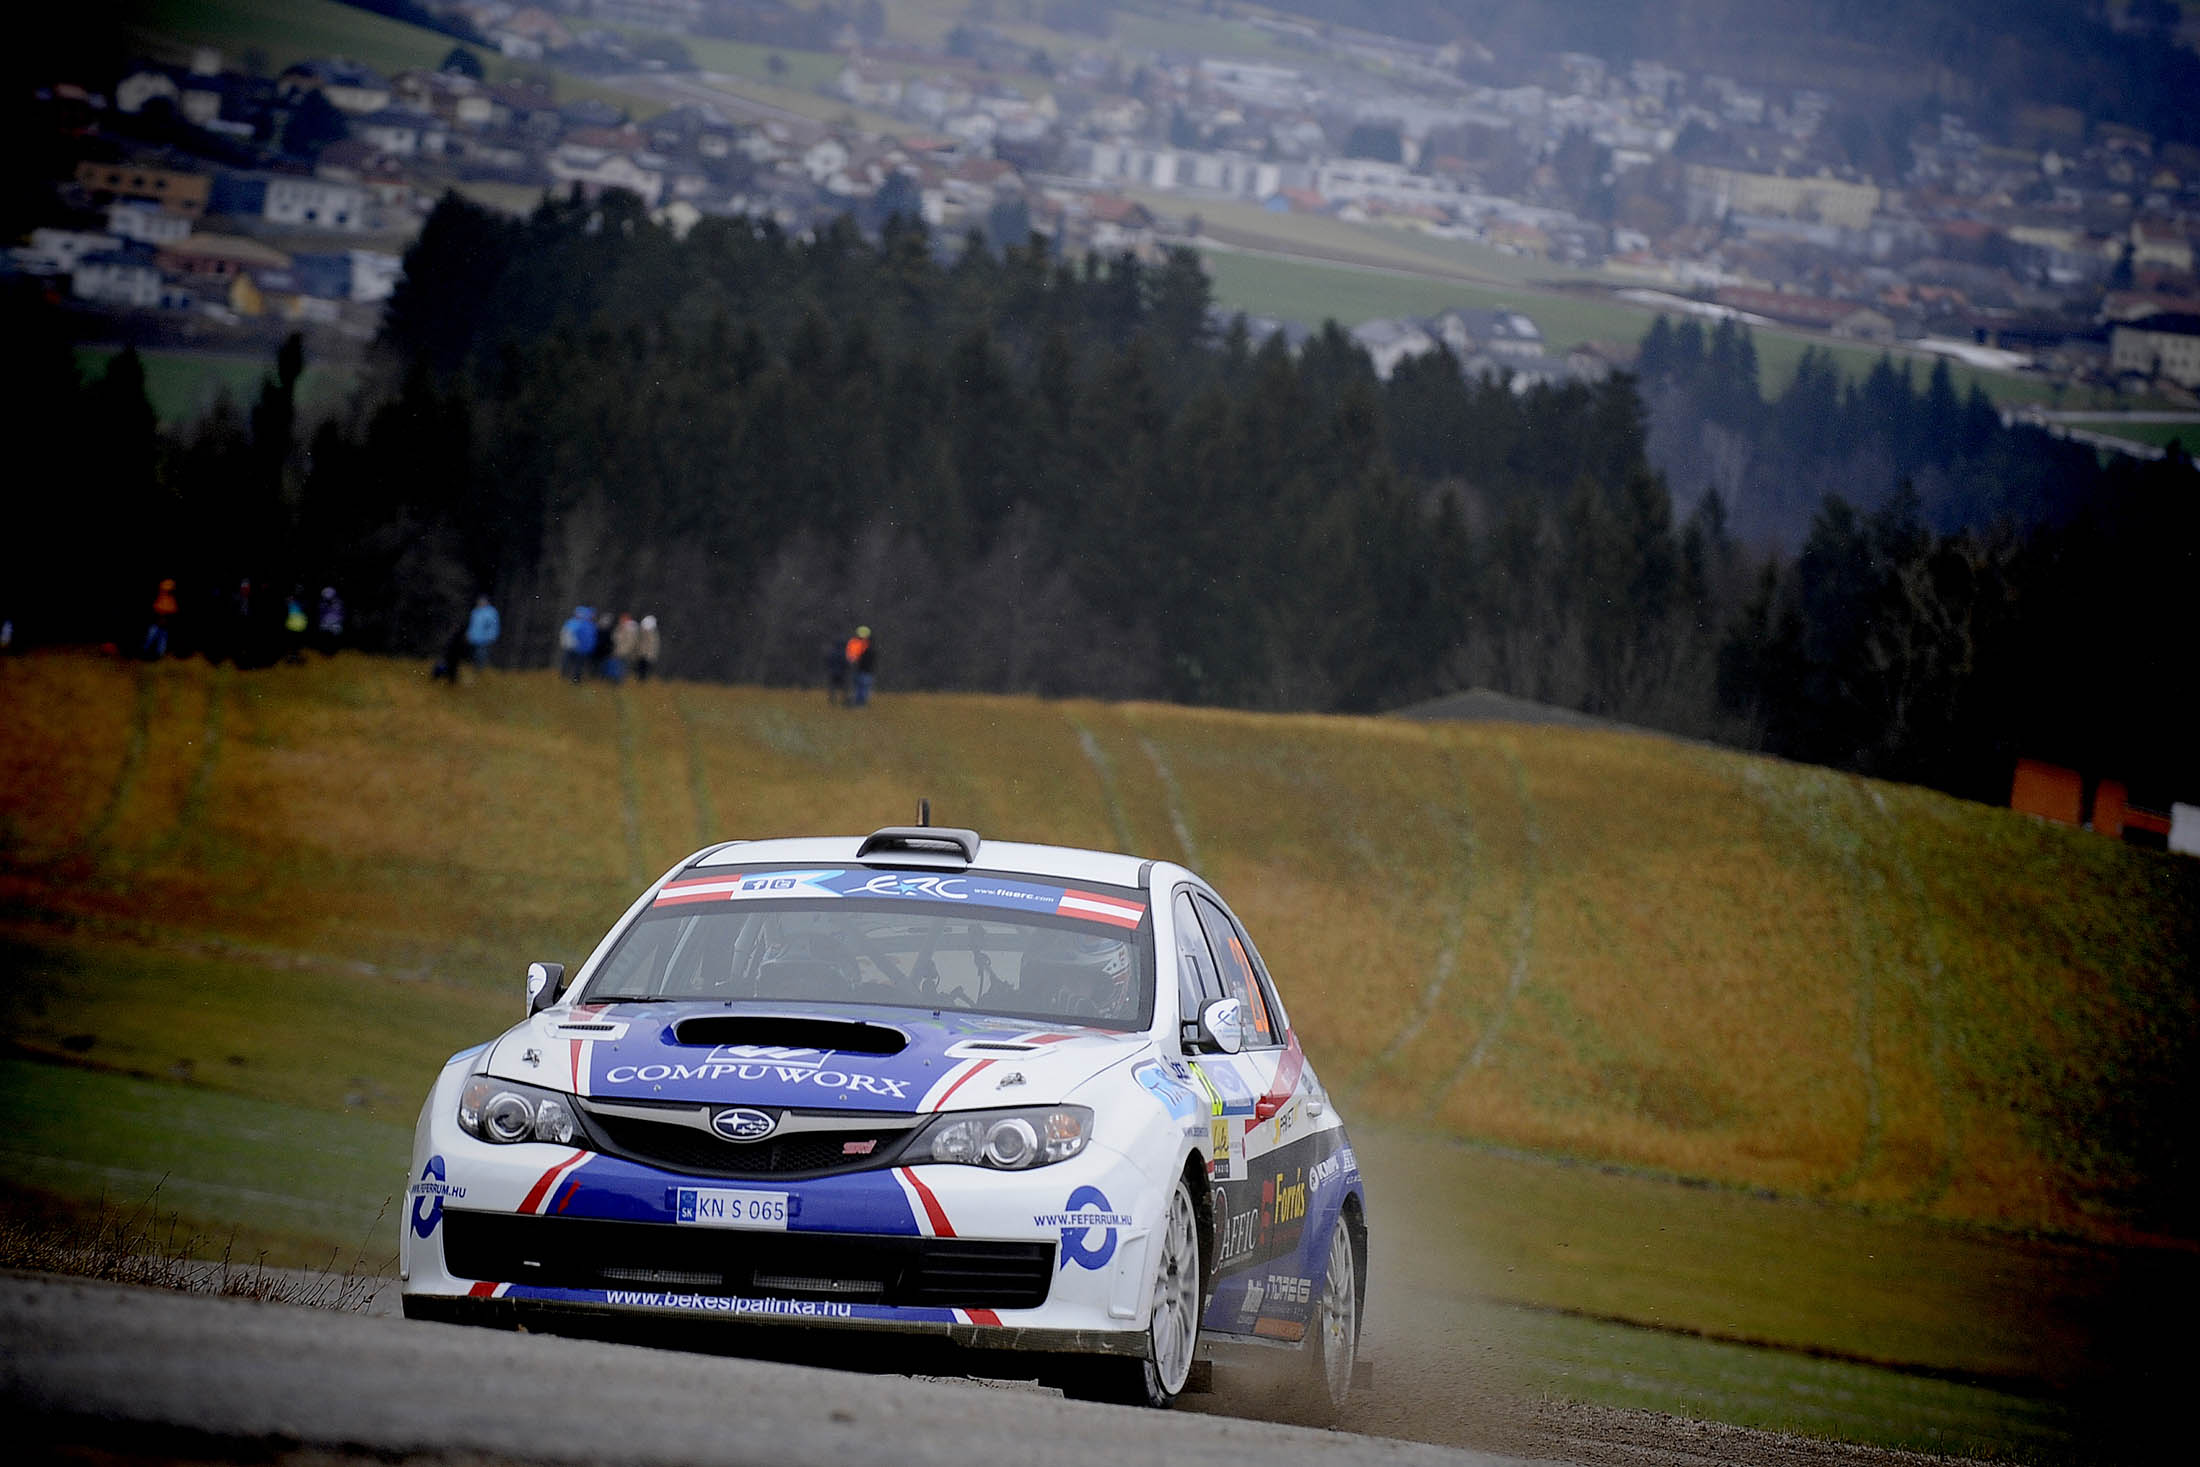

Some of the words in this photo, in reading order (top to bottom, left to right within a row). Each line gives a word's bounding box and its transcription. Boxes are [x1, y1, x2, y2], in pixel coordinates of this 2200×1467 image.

[844, 875, 968, 900] ERC
[606, 1064, 911, 1098] COMPUWORX
[1274, 1167, 1305, 1224] Forrás
[681, 1207, 693, 1218] SK
[700, 1198, 724, 1217] KN
[732, 1200, 742, 1218] S
[749, 1201, 784, 1220] 065
[1033, 1214, 1133, 1226] WWW.FEFERRUM.HU
[605, 1290, 851, 1316] www.bekesipalinka.hu
